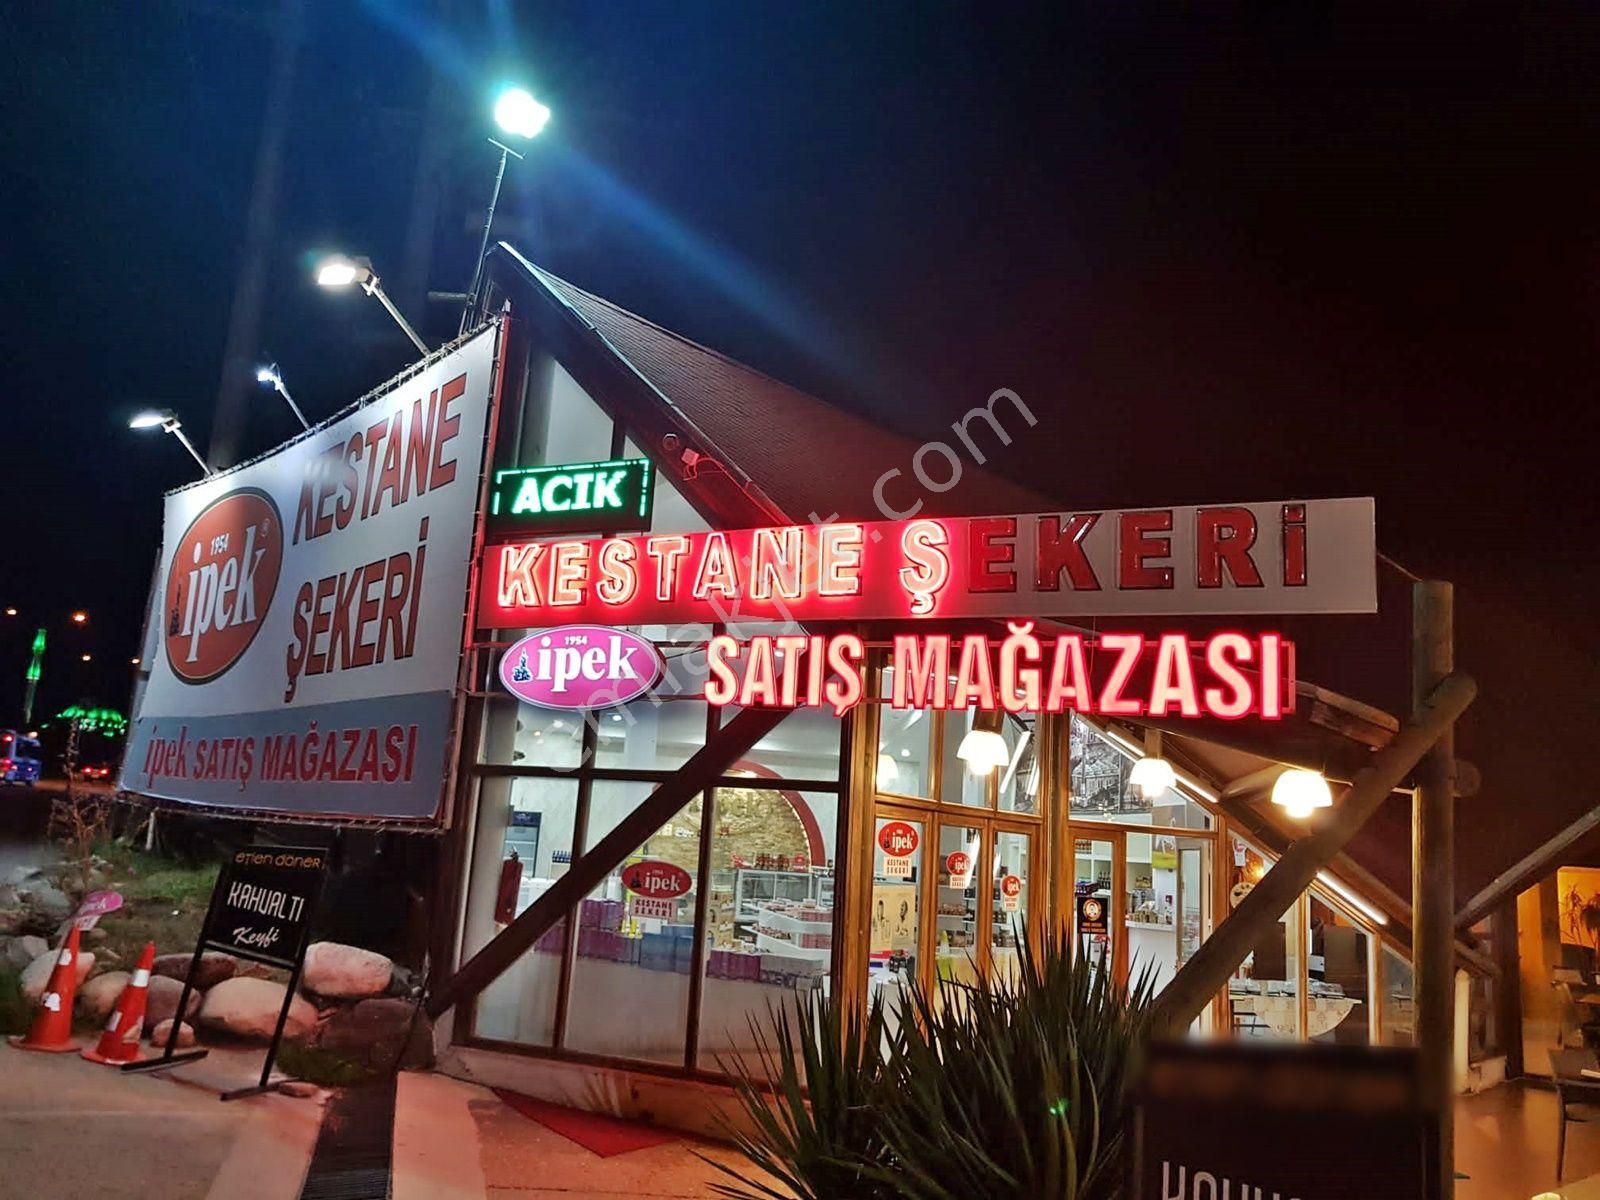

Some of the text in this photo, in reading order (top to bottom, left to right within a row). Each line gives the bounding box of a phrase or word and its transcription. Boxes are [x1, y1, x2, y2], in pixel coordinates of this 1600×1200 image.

[292, 372, 467, 546] KESTANE
[210, 533, 230, 556] 1954
[497, 525, 864, 609] KESTANE
[180, 525, 266, 663] ipek
[283, 516, 430, 703] ŞEKERİ
[535, 635, 639, 693] ipek
[564, 635, 588, 646] 1954
[703, 620, 1283, 721] SATIŞ MAĞAZASI
[141, 719, 420, 792] ipek SATIŞ MAĞAZASI
[644, 872, 681, 894] ipek
[232, 926, 280, 948] Keyfi
